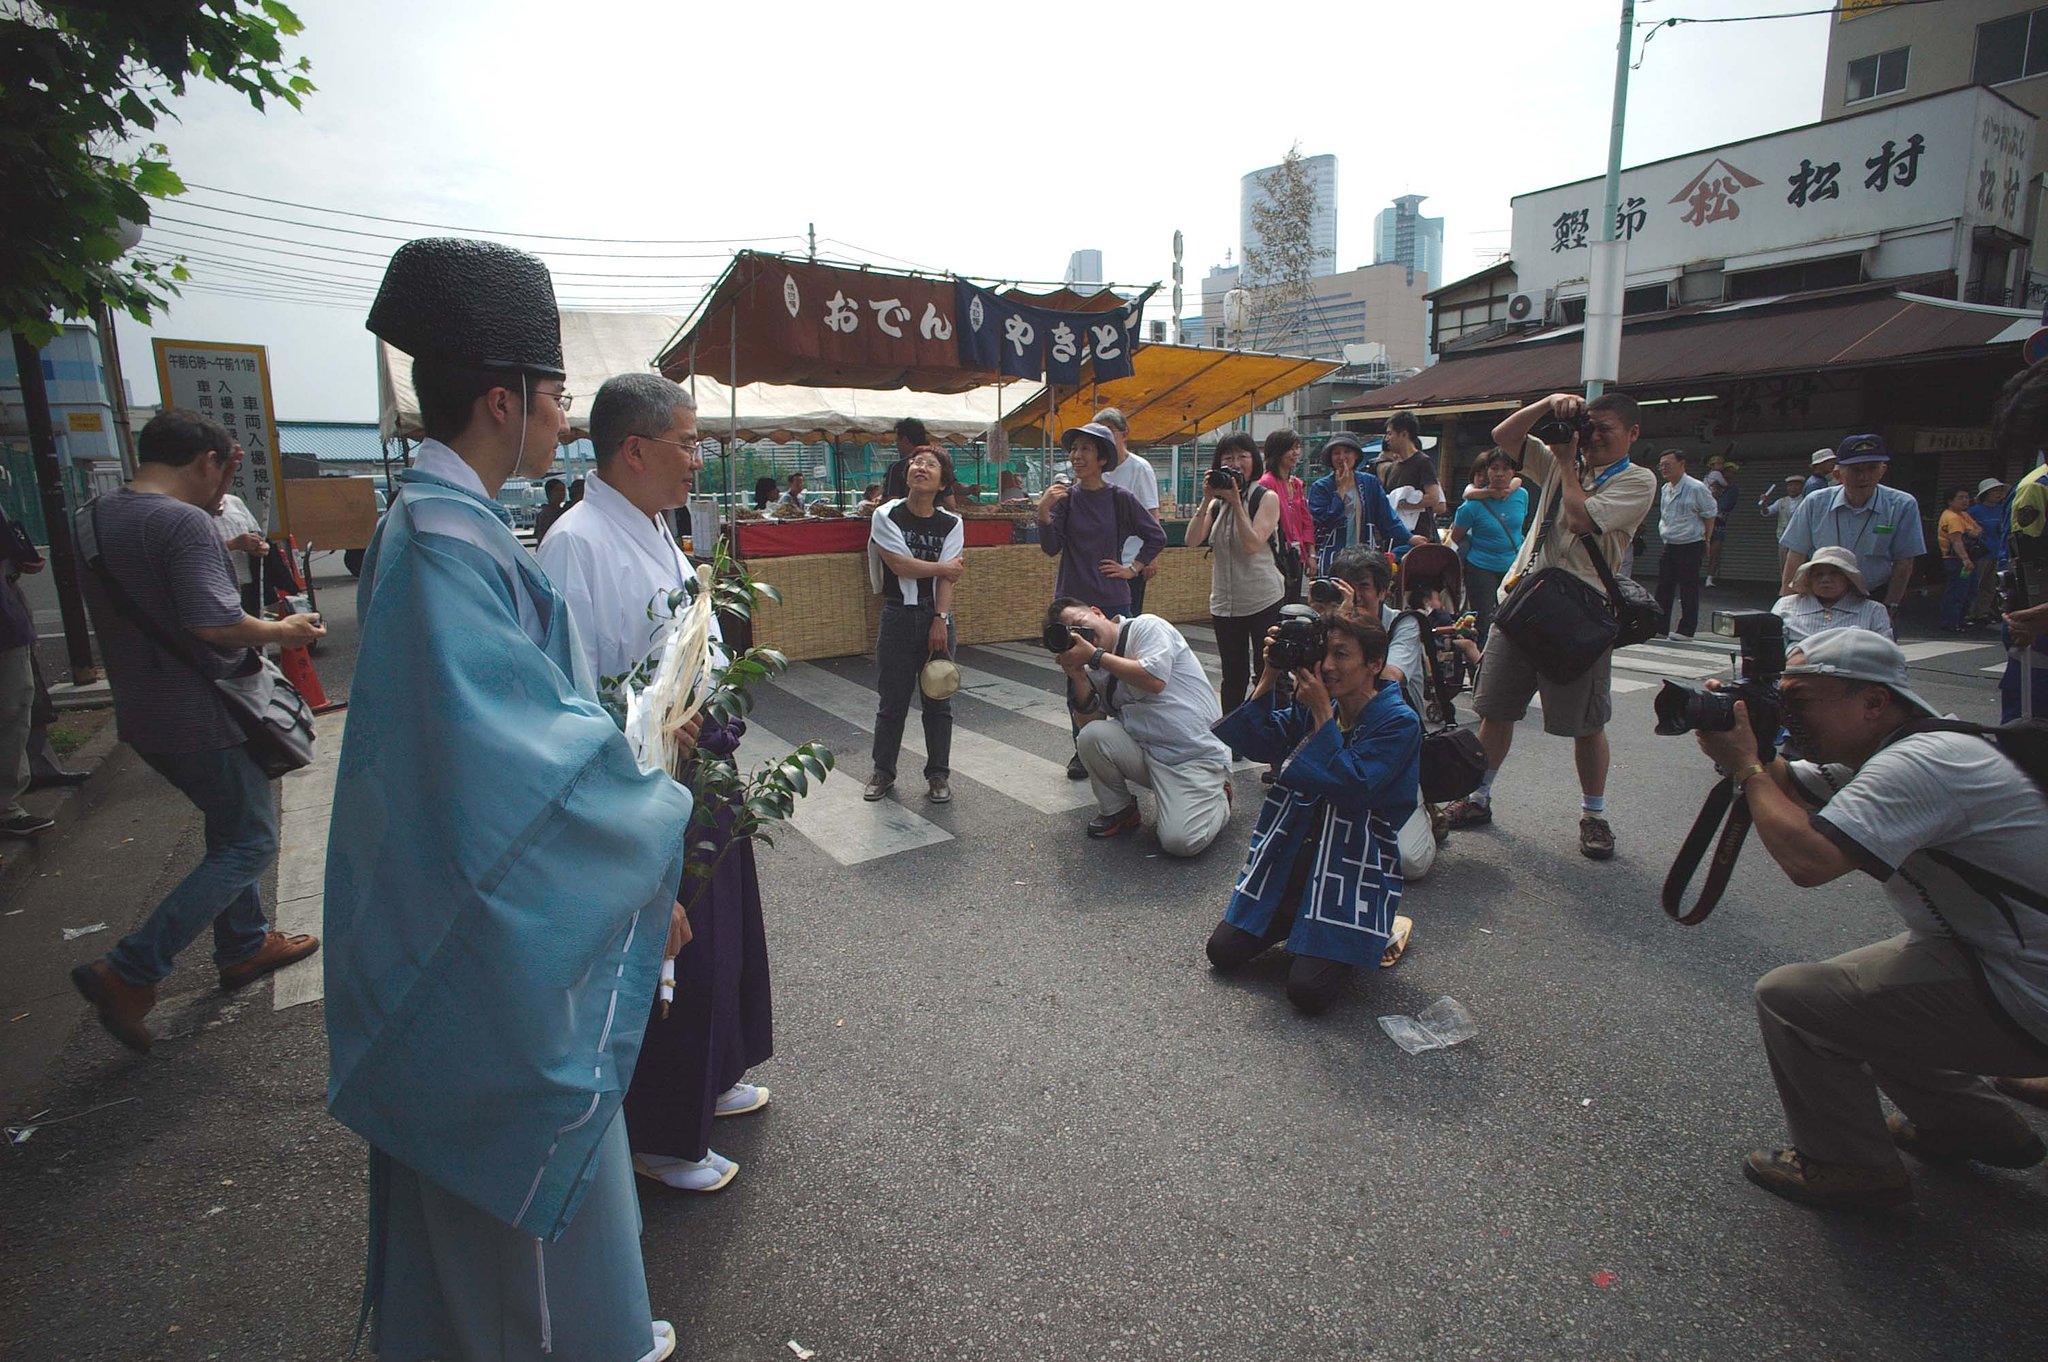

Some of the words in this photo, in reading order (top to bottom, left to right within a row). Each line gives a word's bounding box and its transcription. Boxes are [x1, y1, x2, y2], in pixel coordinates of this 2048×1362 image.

[1788, 133, 1926, 208] 松村
[1977, 153, 2021, 220] 松村
[824, 290, 952, 340] おでん
